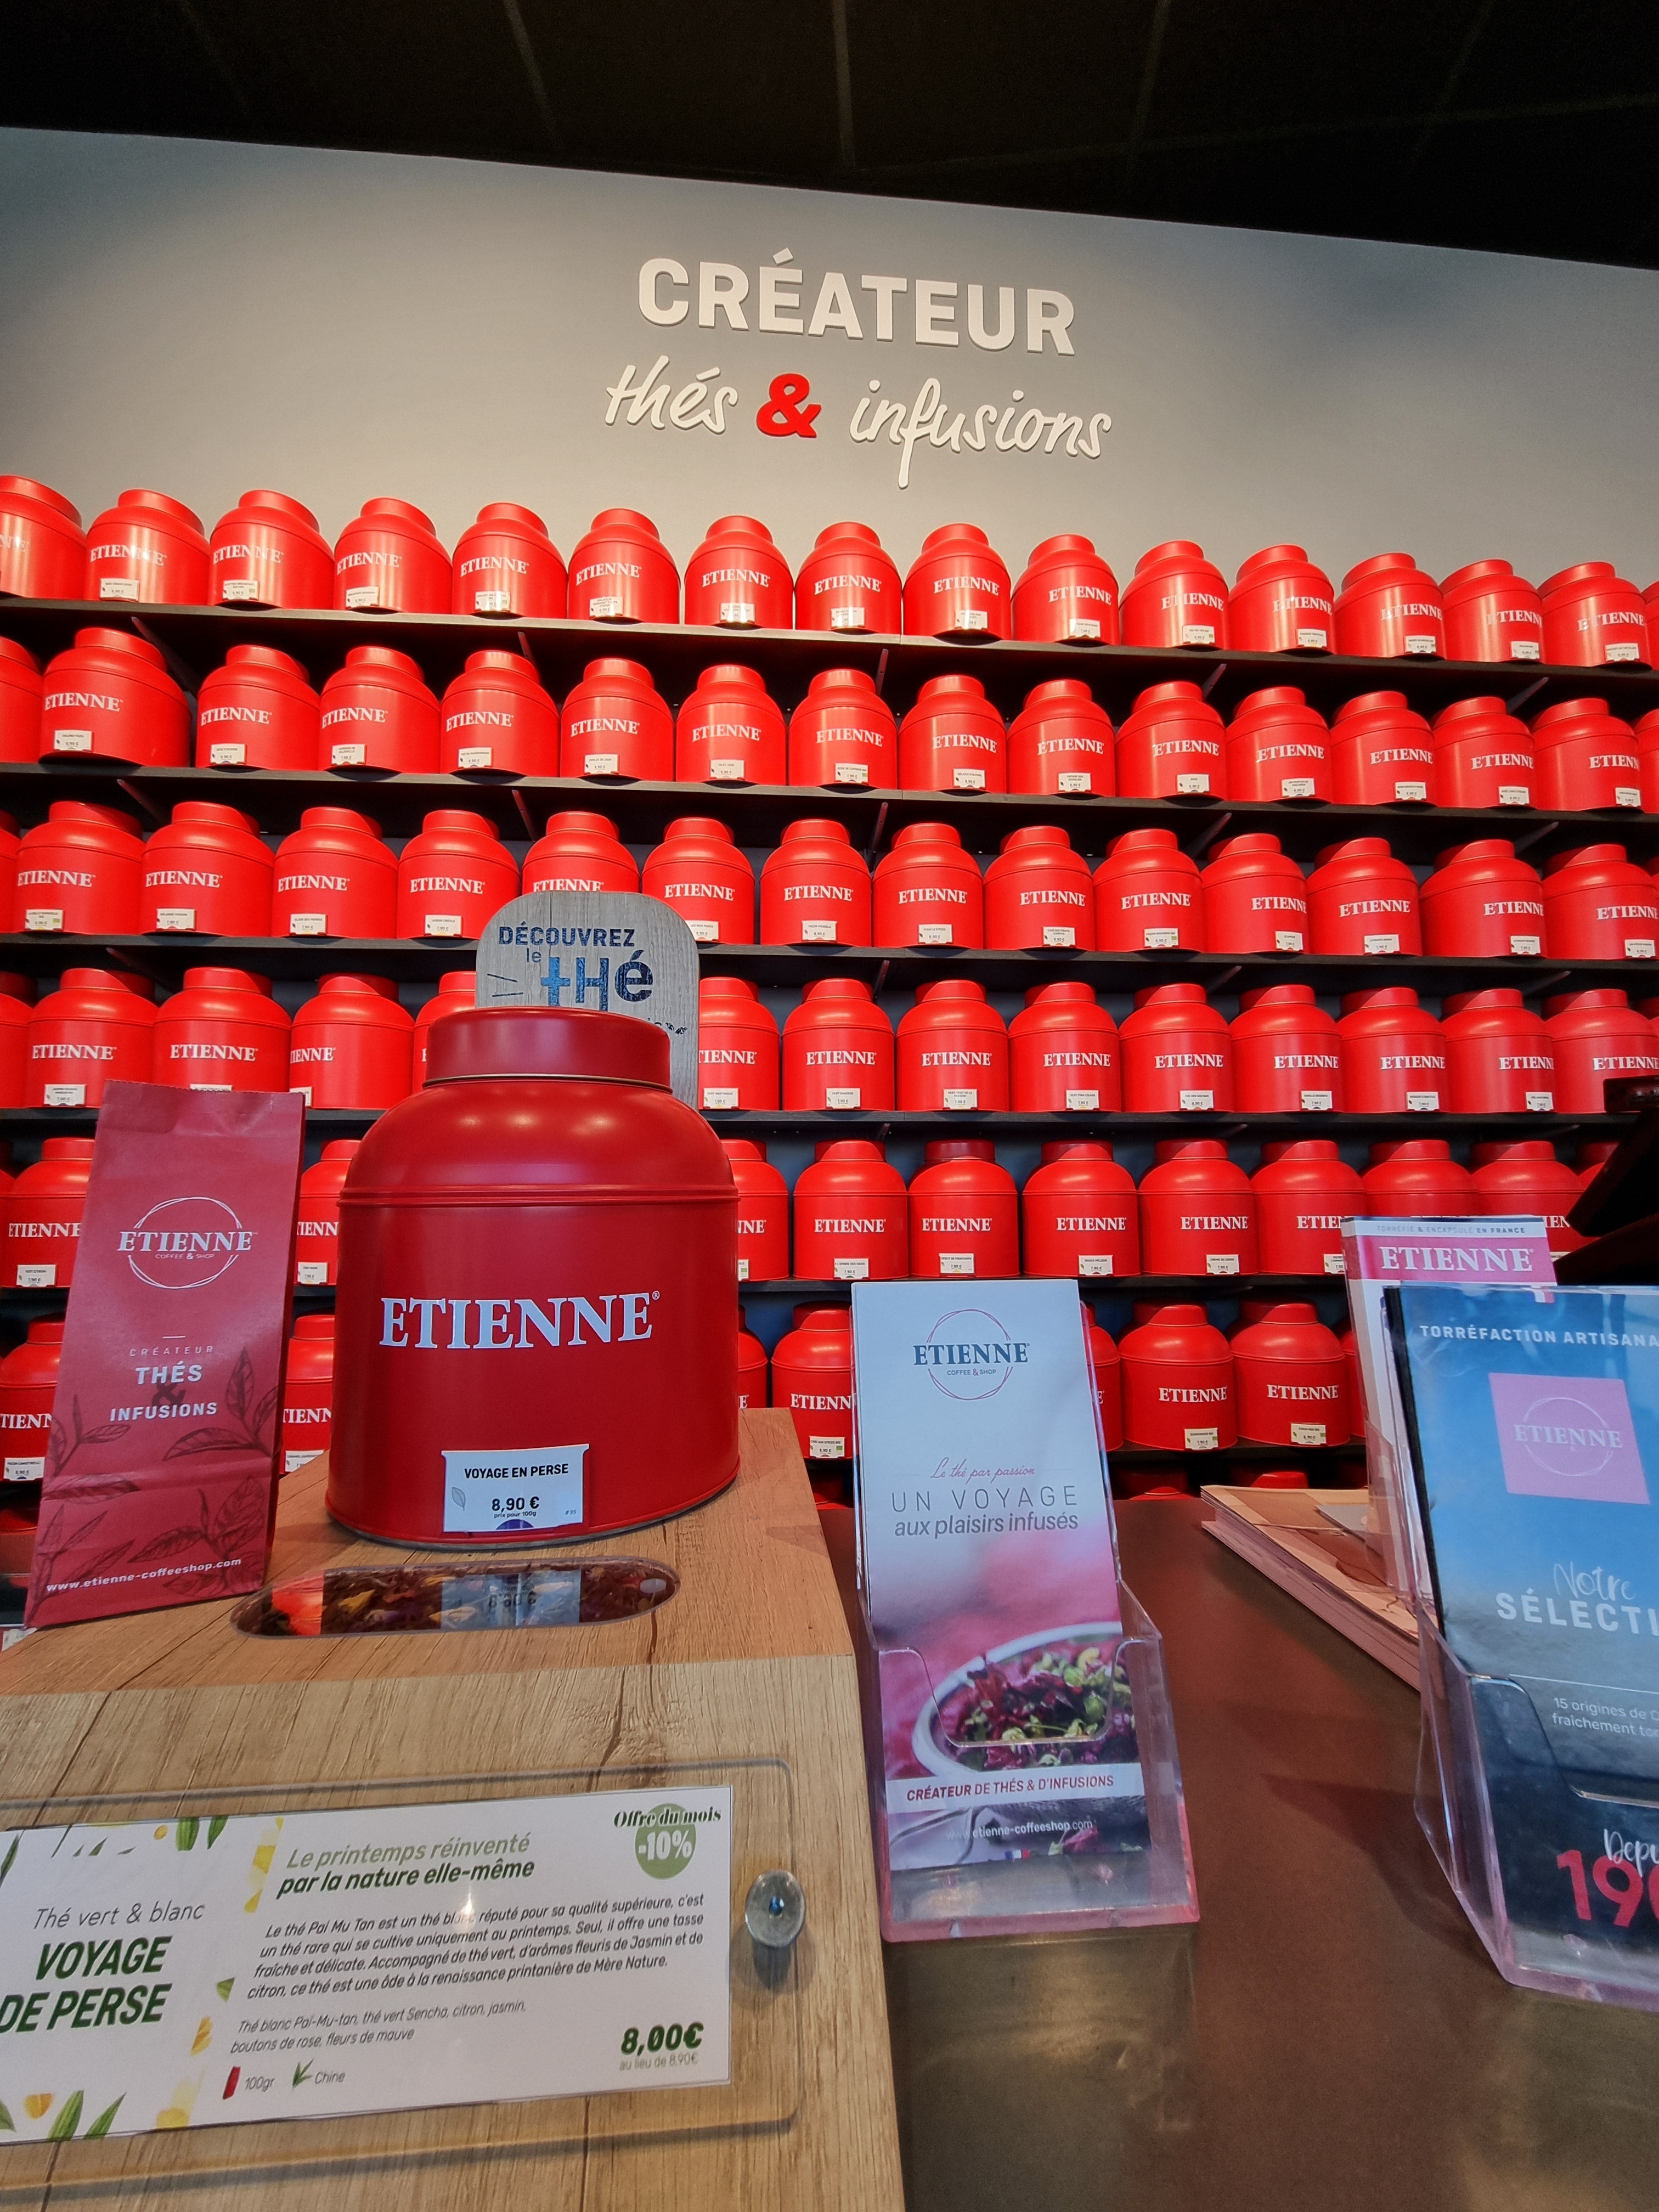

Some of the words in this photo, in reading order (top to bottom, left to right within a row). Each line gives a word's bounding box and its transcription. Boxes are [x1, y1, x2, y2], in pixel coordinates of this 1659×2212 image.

[638, 247, 1075, 357] CRÉATEUR
[604, 355, 738, 434] thés
[756, 373, 822, 438] &
[849, 377, 1112, 489] infusions
[460, 556, 527, 577] ETIENNE
[576, 562, 640, 586] ETIENNE
[702, 568, 769, 588] ETIENNE
[814, 575, 881, 595] ETIENNE
[934, 576, 999, 597] ETIENNE
[1048, 585, 1112, 606] ETIENNE
[45, 692, 122, 712] ETIENNE
[571, 718, 638, 735] ETIENNE
[692, 724, 760, 741] ETIENNE
[933, 734, 997, 753] ETIENNE
[1037, 737, 1104, 754] ETIENNE
[1369, 748, 1434, 765] ETIENNE
[18, 870, 94, 887] ETIENNE
[146, 871, 222, 888] ETIENNE
[278, 874, 349, 892] ETIENNE
[410, 877, 485, 894] ETIENNE
[664, 883, 735, 901] ETIENNE
[899, 888, 968, 904] ETIENNE
[1020, 890, 1087, 906] ETIENNE
[1121, 892, 1192, 910] ETIENNE
[1339, 900, 1412, 917] ETIENNE
[499, 922, 635, 947] DÉCOUVREZ
[526, 948, 542, 963] le
[32, 1044, 115, 1060] ETIENNE
[170, 1043, 257, 1061] ETIENNE
[922, 1051, 992, 1066] ETIENNE
[1043, 1052, 1112, 1067] ETIENNE
[1154, 1054, 1224, 1069] ETIENNE
[1274, 1054, 1340, 1069] ETIENNE
[814, 1219, 886, 1233] ETIENNE
[922, 1218, 992, 1232] ETIENNE
[1057, 1217, 1127, 1231] ETIENNE
[1181, 1216, 1249, 1229] ETIENNE
[117, 1231, 253, 1252] ETIENNE
[186, 1252, 194, 1260] &
[1420, 1324, 1556, 1344] TORRÉFACTION
[129, 1345, 215, 1357] CRÉATEUR
[913, 1342, 1027, 1367] ETIENNE
[135, 1361, 203, 1385] THÉS
[1159, 1387, 1227, 1403] ETIENNE
[1267, 1384, 1338, 1400] ETIENNE
[110, 1402, 218, 1423] INFUSIONS
[1513, 1424, 1623, 1449] ETIENNE
[464, 1468, 509, 1479] VOYAGE
[512, 1466, 527, 1477] EN
[531, 1463, 569, 1476] PERSE
[930, 1457, 949, 1479] Le
[950, 1458, 967, 1477] thé
[966, 1468, 991, 1484] par
[990, 1465, 1036, 1483] passion
[492, 1497, 525, 1513] 8,90
[529, 1496, 539, 1509] €
[891, 1491, 932, 1513] UN
[951, 1485, 1077, 1510] VOYAGE
[895, 1520, 931, 1536] aux
[934, 1515, 1004, 1539] plaisirs
[1009, 1511, 1079, 1532] infusés
[46, 1558, 242, 1592] www.etienne-coffeeshop.com
[1554, 1562, 1635, 1602] Notre
[1496, 1588, 1659, 1637] SÉLECTI
[1553, 1697, 1568, 1710] 15
[1572, 1700, 1626, 1718] origines
[1629, 1707, 1646, 1719] de
[1551, 1713, 1636, 1735] fraichement
[906, 1783, 971, 1802] CRÉATEUR
[974, 1782, 991, 1796] DE
[994, 1778, 1024, 1794] THÉS
[1027, 1779, 1035, 1792] &
[1038, 1775, 1114, 1790] D'INFUSIONS
[613, 1810, 657, 1828] Offre
[658, 1808, 681, 1826] du
[682, 1806, 721, 1824] mois
[287, 1849, 314, 1869] Le
[315, 1844, 426, 1871] printemps
[431, 1832, 531, 1859] réinventé
[637, 1830, 692, 1860] -10%
[276, 1877, 320, 1900] par
[320, 1871, 343, 1892] la
[345, 1867, 419, 1890] nature
[424, 1858, 534, 1884] elle-même
[34, 1907, 72, 1929] Thé
[79, 1906, 119, 1926] vert
[126, 1903, 143, 1924] &
[149, 1900, 205, 1922] blanc
[259, 1946, 277, 1958] un
[280, 1941, 302, 1957] thé
[303, 1943, 329, 1955] rare
[332, 1938, 354, 1955] qui
[355, 1939, 370, 1950] se
[373, 1934, 414, 1950] cultive
[416, 1928, 488, 1948] uniquement
[491, 1929, 507, 1940] au
[509, 1923, 571, 1942] printemps.
[576, 1920, 602, 1934] Seul,
[607, 1918, 615, 1931] il
[617, 1916, 644, 1931] offre
[648, 1917, 669, 1928] une
[673, 1914, 703, 1927] tasse
[36, 1936, 172, 1980] VOYAGE
[247, 1984, 286, 1999] citron,
[291, 1984, 307, 1996] ce
[309, 1977, 331, 1994] thé
[332, 1978, 353, 1993] est
[355, 1978, 379, 1990] une
[407, 1972, 415, 1987] à
[417, 1972, 430, 1986] la
[431, 1968, 505, 1985] renaissance
[507, 1962, 573, 1982] printanière
[576, 1960, 591, 1973] de
[594, 1957, 623, 1972] Mère
[625, 1955, 667, 1970] Nature.
[0, 1992, 50, 2034] DE
[47, 1983, 172, 2030] PERSE
[620, 2022, 704, 2056] 8,00€
[619, 2060, 631, 2070] au
[634, 2057, 651, 2069] lieu
[654, 2056, 666, 2068] de
[315, 2072, 345, 2084] Chine
